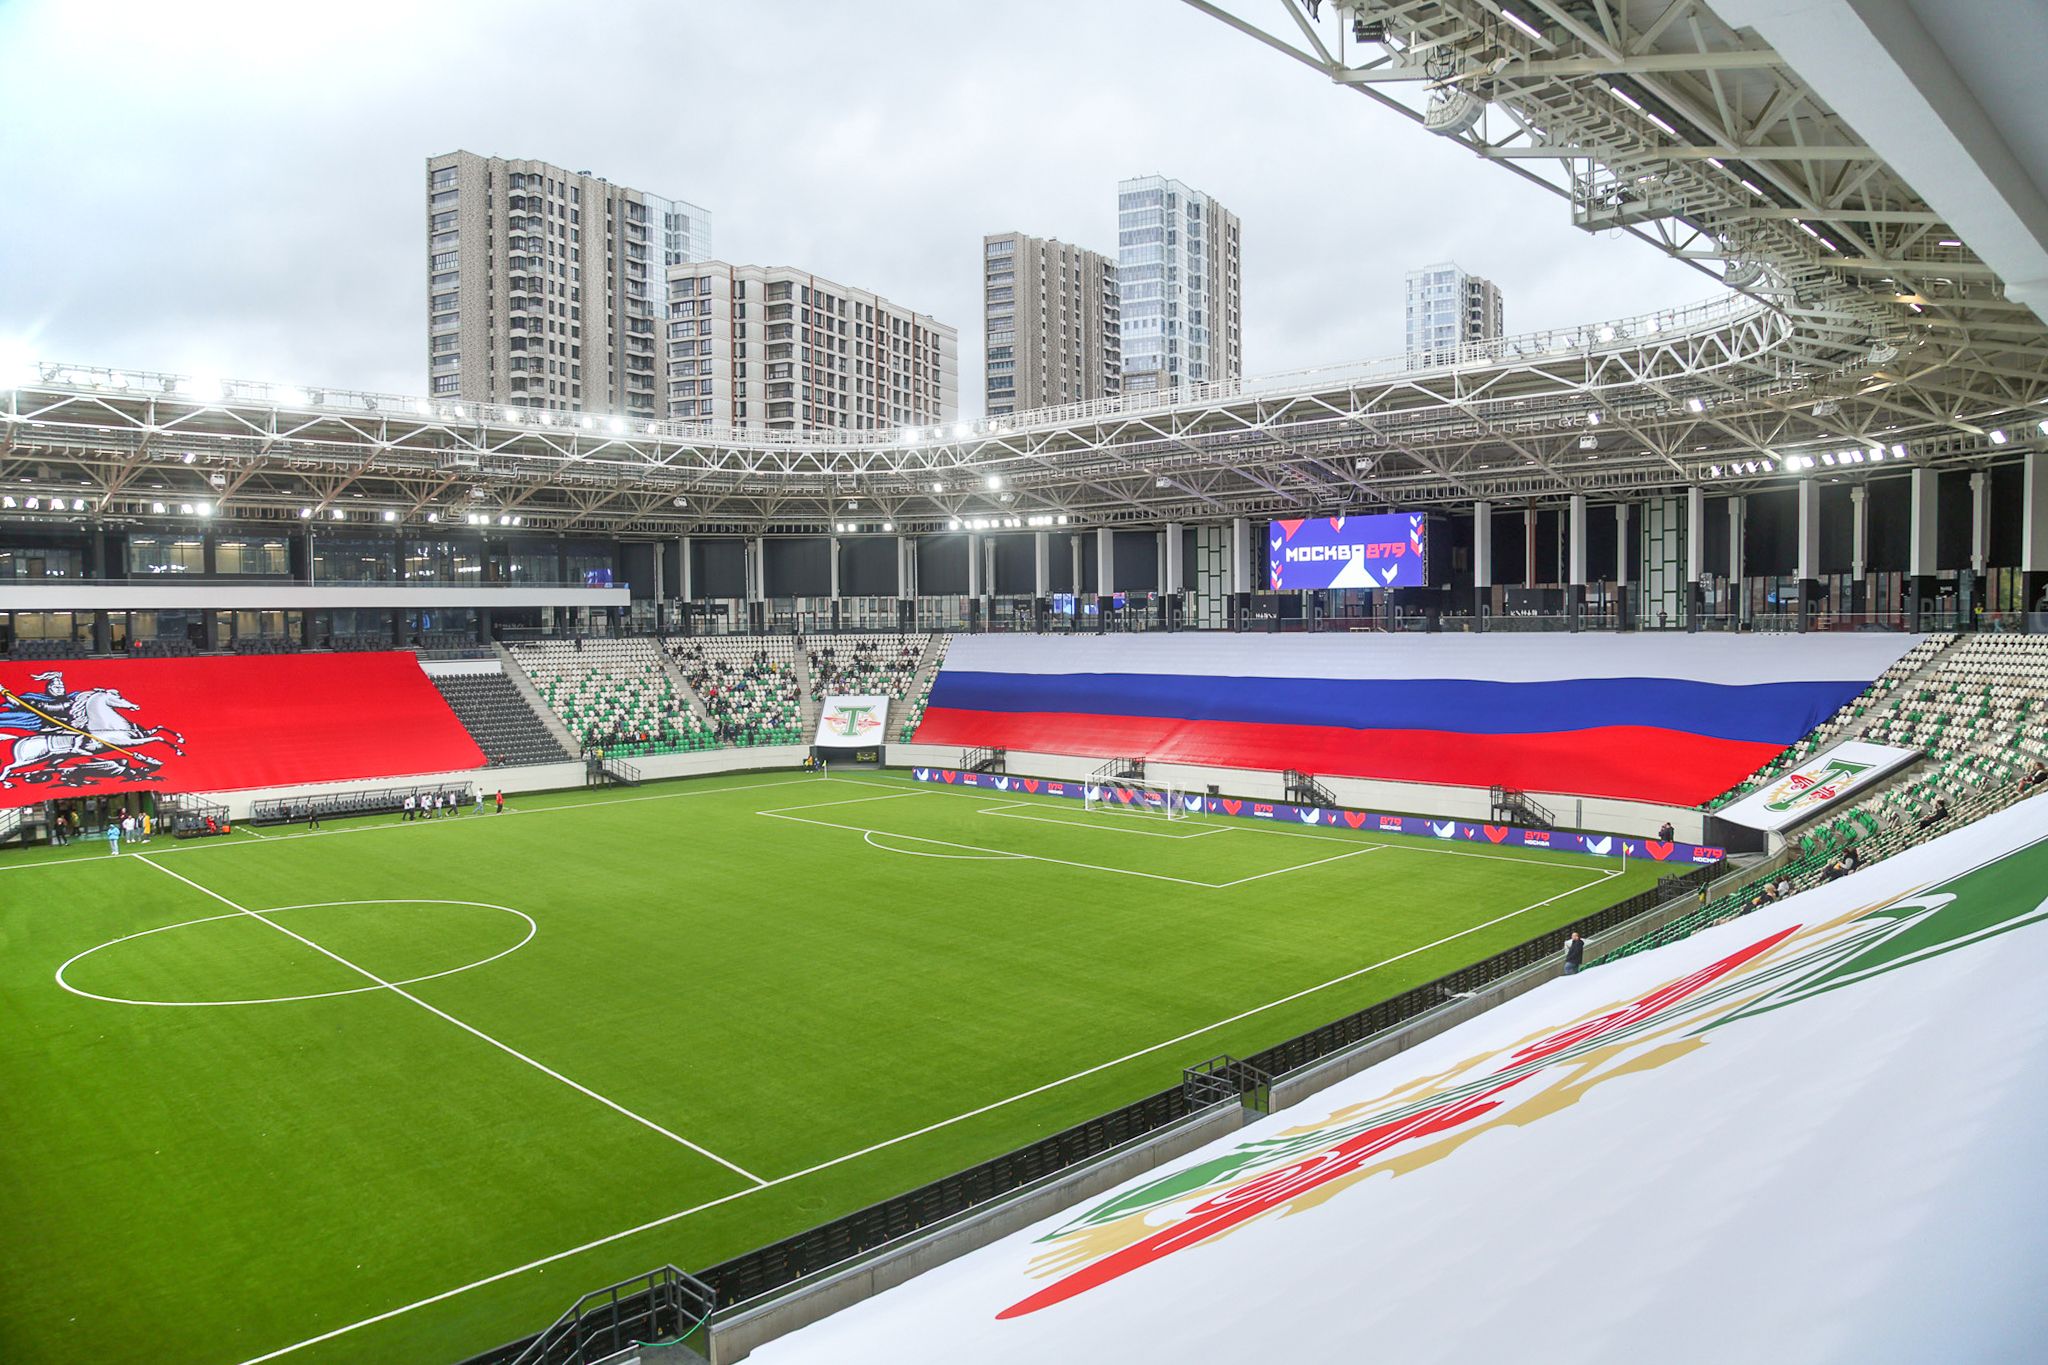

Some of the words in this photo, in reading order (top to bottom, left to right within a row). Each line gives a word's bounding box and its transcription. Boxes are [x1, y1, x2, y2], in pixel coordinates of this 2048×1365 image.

[1286, 544, 1364, 562] МОСКВА
[1366, 542, 1406, 559] 879
[1380, 816, 1402, 826] 879
[1524, 831, 1550, 841] 879
[1693, 846, 1723, 858] 879
